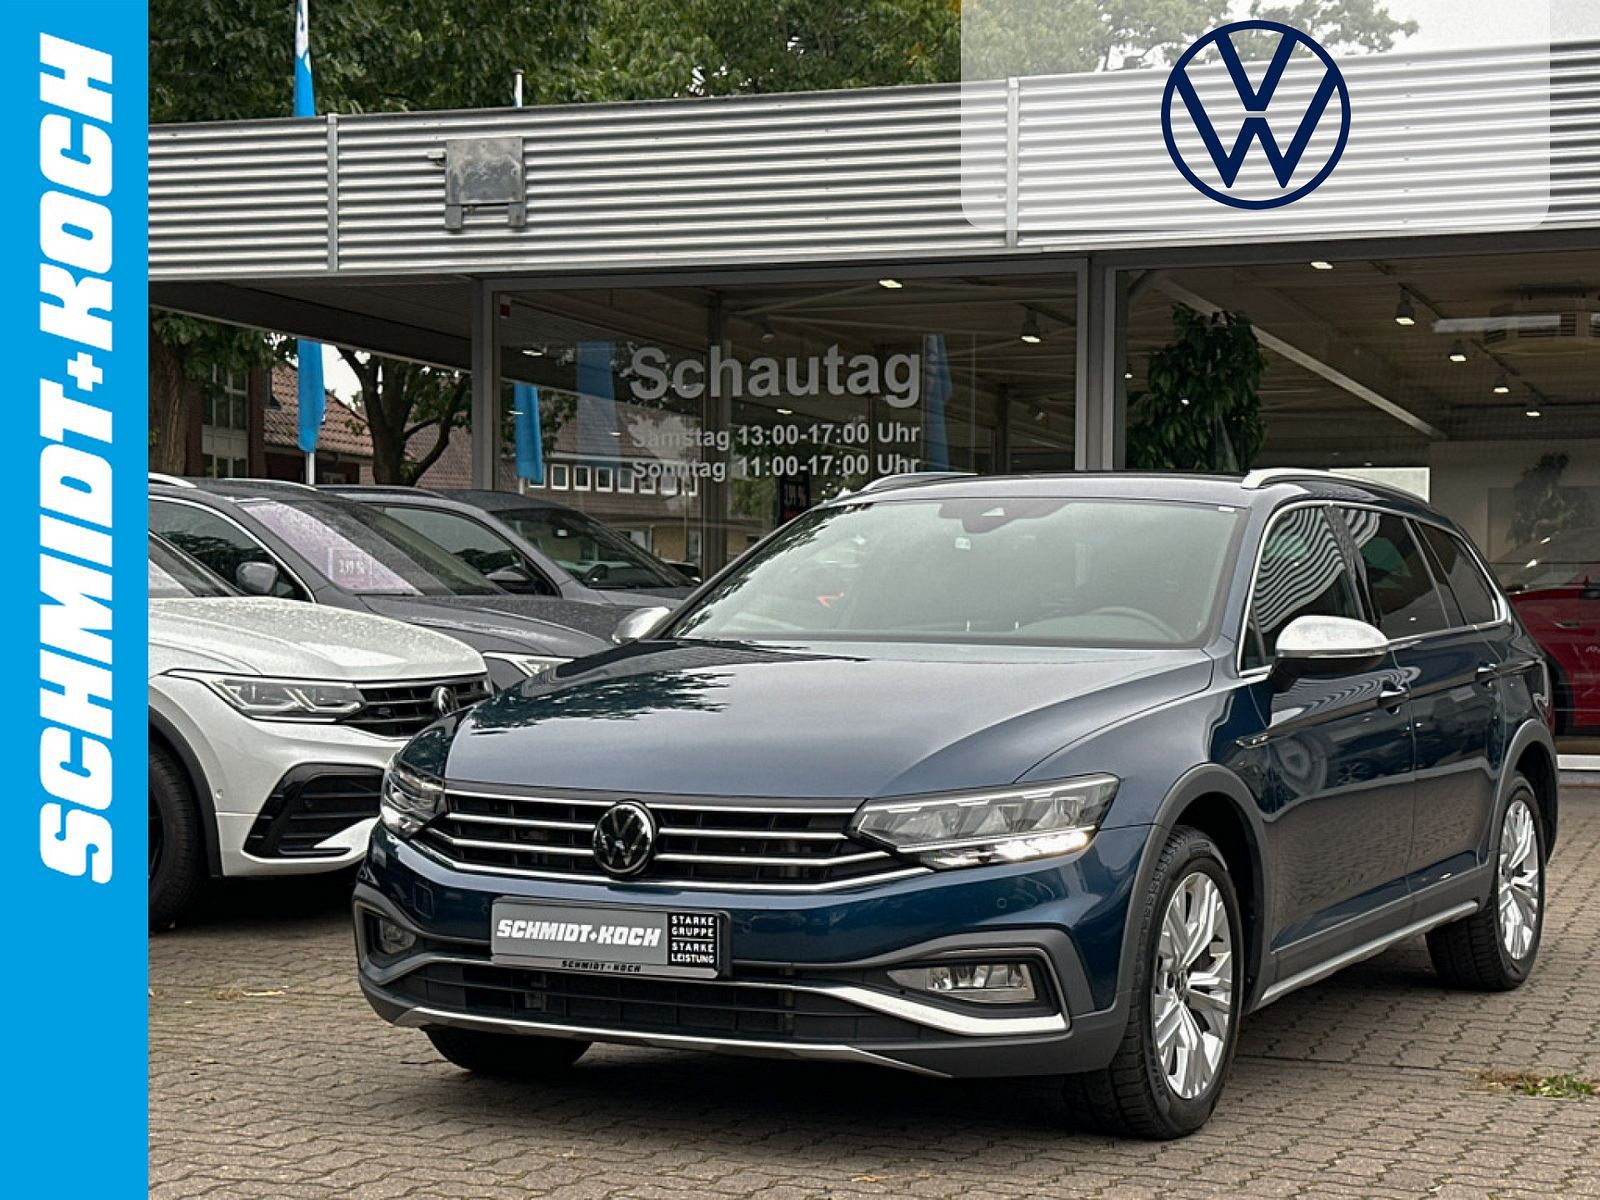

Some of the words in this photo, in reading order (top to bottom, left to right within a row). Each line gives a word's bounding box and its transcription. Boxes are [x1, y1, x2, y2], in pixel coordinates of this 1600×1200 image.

[629, 344, 922, 408] Schautag
[631, 424, 730, 451] Samstag
[737, 423, 871, 446] 13:00-17:00
[877, 422, 921, 444] Uhr
[632, 459, 726, 482] Sonntag
[737, 454, 870, 476] 11:00-17:00
[877, 453, 920, 475] Uhr
[671, 915, 714, 926] STARKE
[496, 919, 662, 947] SCHMIDT+KOCH
[671, 926, 714, 937] GRUPPE
[671, 941, 714, 952] STARKE
[671, 952, 715, 964] LEISTUNG
